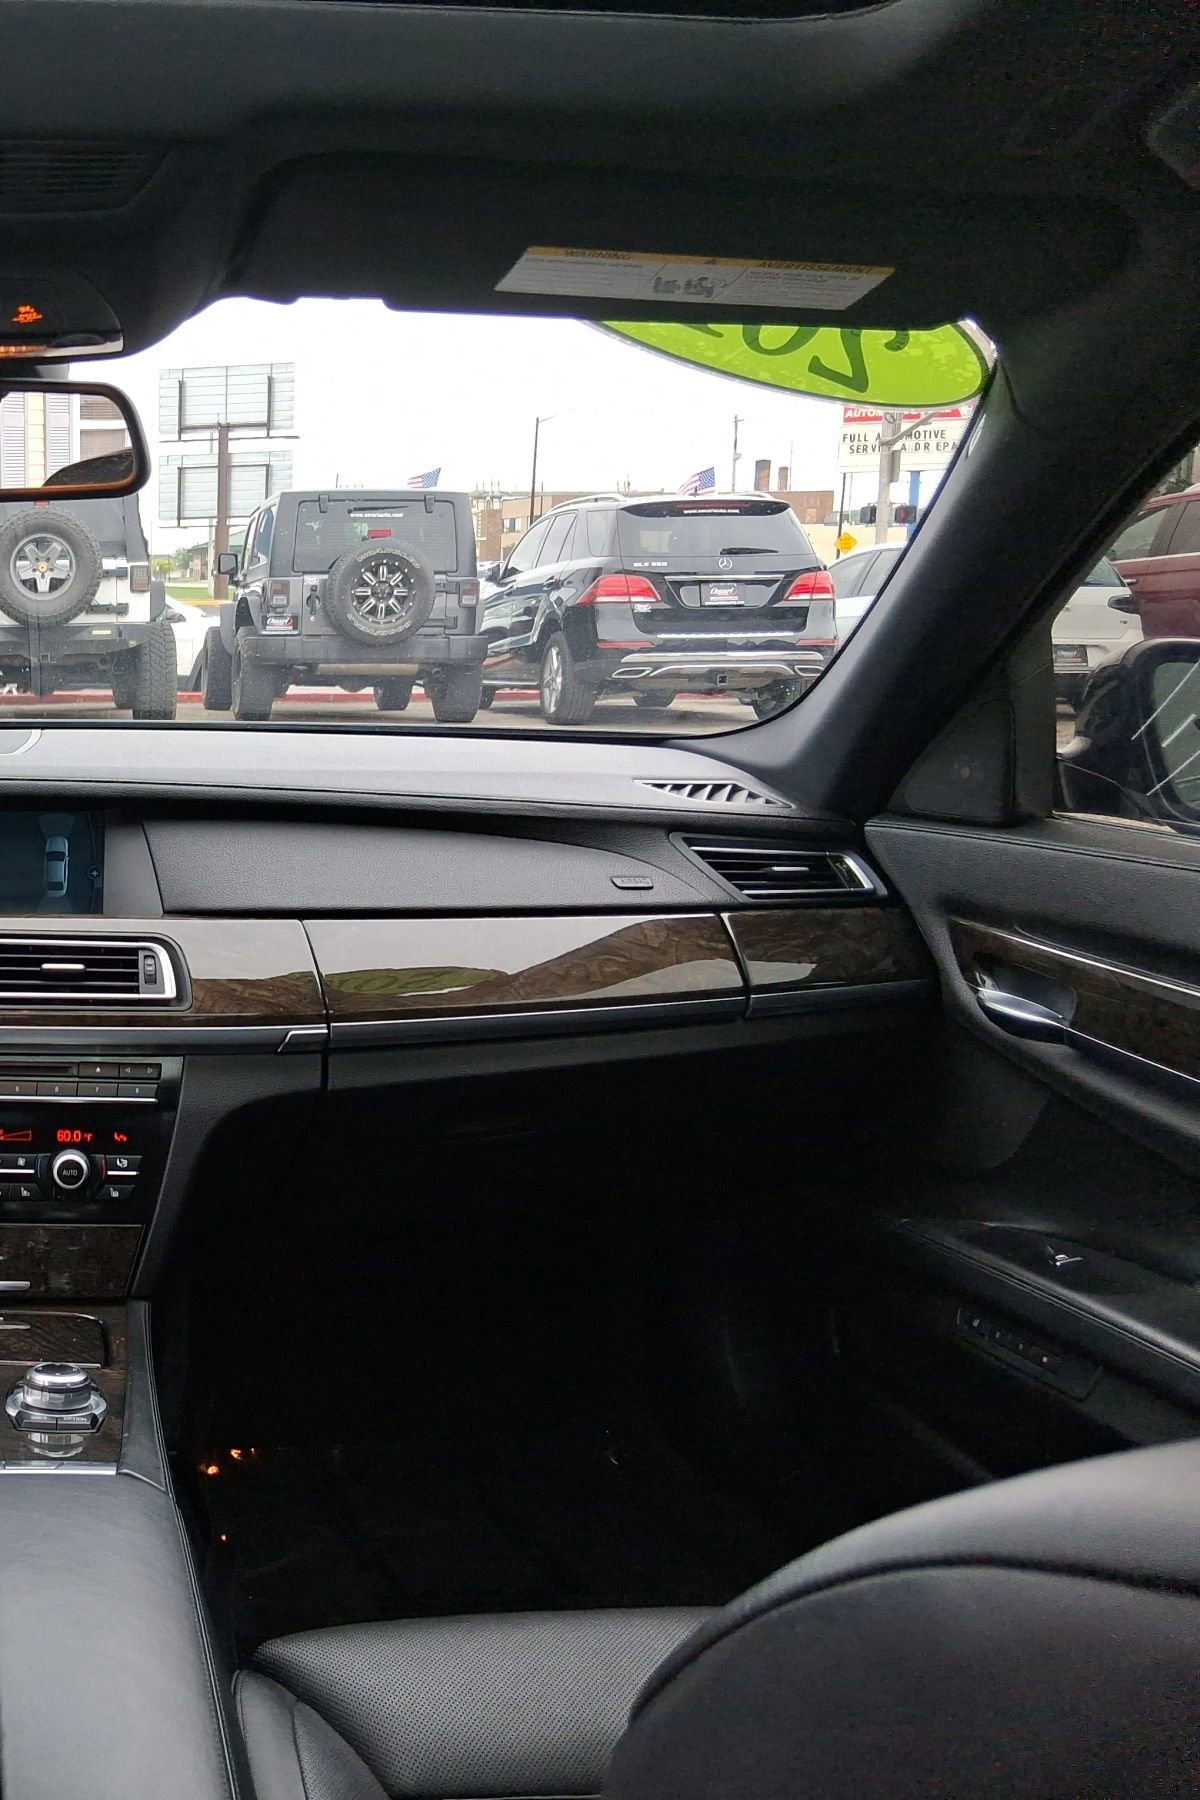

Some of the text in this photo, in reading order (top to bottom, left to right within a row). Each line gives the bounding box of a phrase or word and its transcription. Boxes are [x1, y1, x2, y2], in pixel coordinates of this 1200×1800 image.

[843, 430, 946, 443] FULL AMOTIVE
[57, 1130, 81, 1142] 60.0
